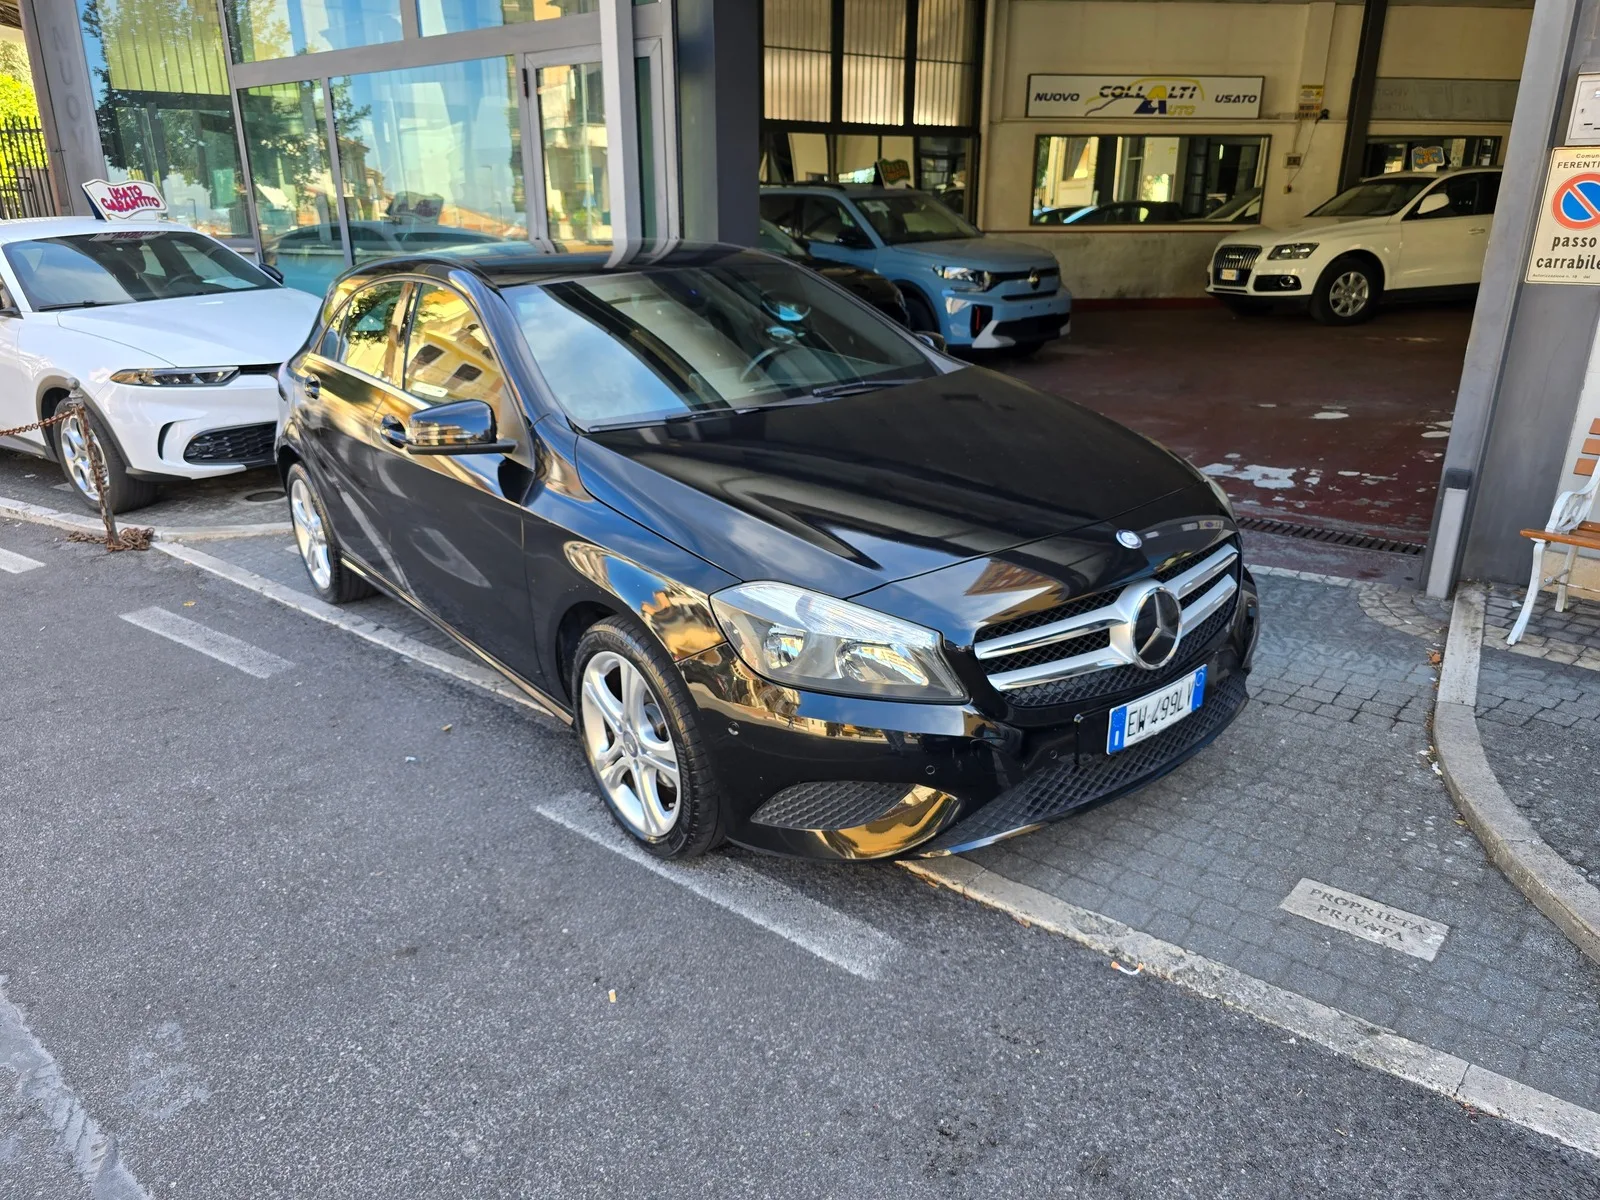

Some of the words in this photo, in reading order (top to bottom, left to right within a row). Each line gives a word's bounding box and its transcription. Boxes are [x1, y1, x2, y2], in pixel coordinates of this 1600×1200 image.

[1034, 92, 1080, 103] NUOVO
[1214, 94, 1257, 104] USATO
[1551, 236, 1597, 251] passo
[1317, 904, 1404, 942] PRIVATA
